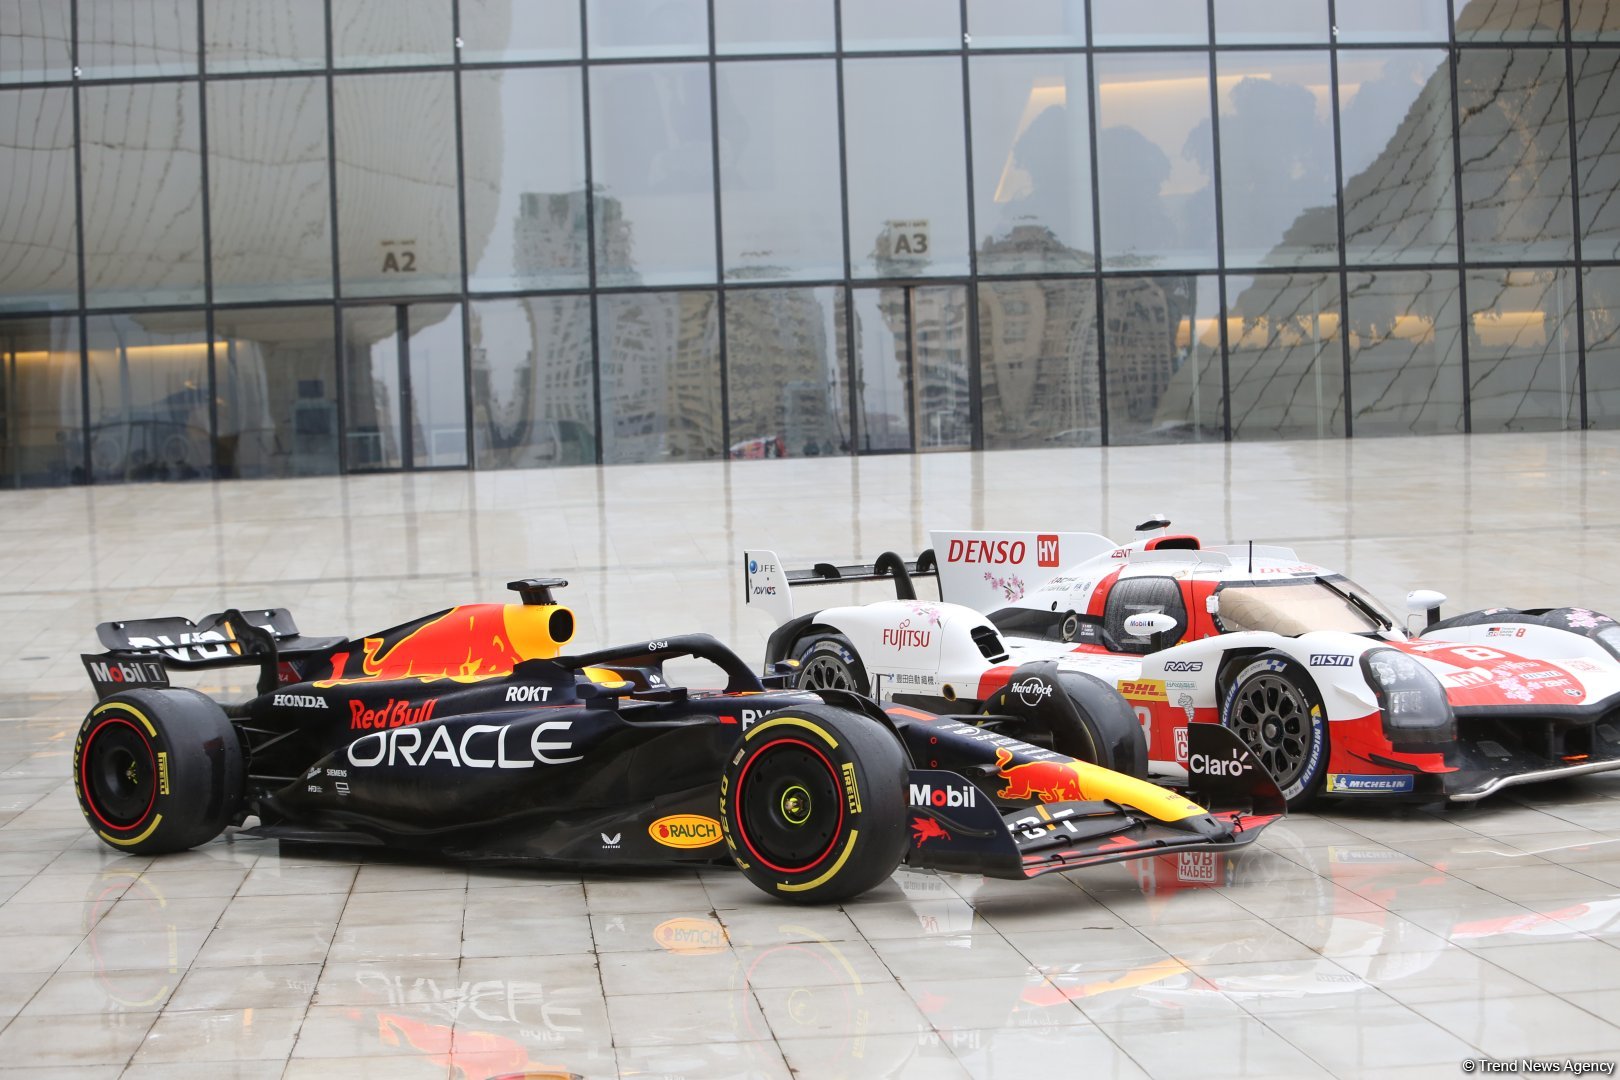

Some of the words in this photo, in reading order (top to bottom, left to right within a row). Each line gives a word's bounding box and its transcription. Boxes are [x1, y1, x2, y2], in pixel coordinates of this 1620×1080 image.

[894, 233, 928, 254] A3
[381, 252, 417, 273] A2
[947, 539, 1026, 565] DENSO
[1039, 541, 1058, 562] HY
[1111, 549, 1132, 558] ZENT
[759, 564, 776, 573] JFE
[883, 628, 931, 651] FUJITSU
[1515, 628, 1526, 638] 8
[1164, 661, 1203, 671] RAYS
[1311, 655, 1353, 666] AISIN
[90, 662, 147, 683] Mobil
[505, 686, 552, 702] ROKT
[1011, 683, 1033, 694] Hard
[1032, 683, 1053, 697] Rock
[1122, 682, 1160, 697] DHL
[273, 694, 329, 709] HONDA
[349, 698, 394, 730] Red
[389, 698, 439, 728] Bull
[348, 721, 584, 769] ORACLE
[1302, 728, 1321, 783] MICHELIN
[158, 751, 170, 795] PIRELLI
[326, 769, 347, 778] SIEMENS
[1190, 754, 1243, 777] Claro
[841, 762, 862, 815] PIRELLI
[1349, 780, 1406, 788] MICHELIN
[909, 784, 976, 808] Mobil
[719, 774, 737, 850] ZERO
[671, 824, 717, 838] RAUCH
